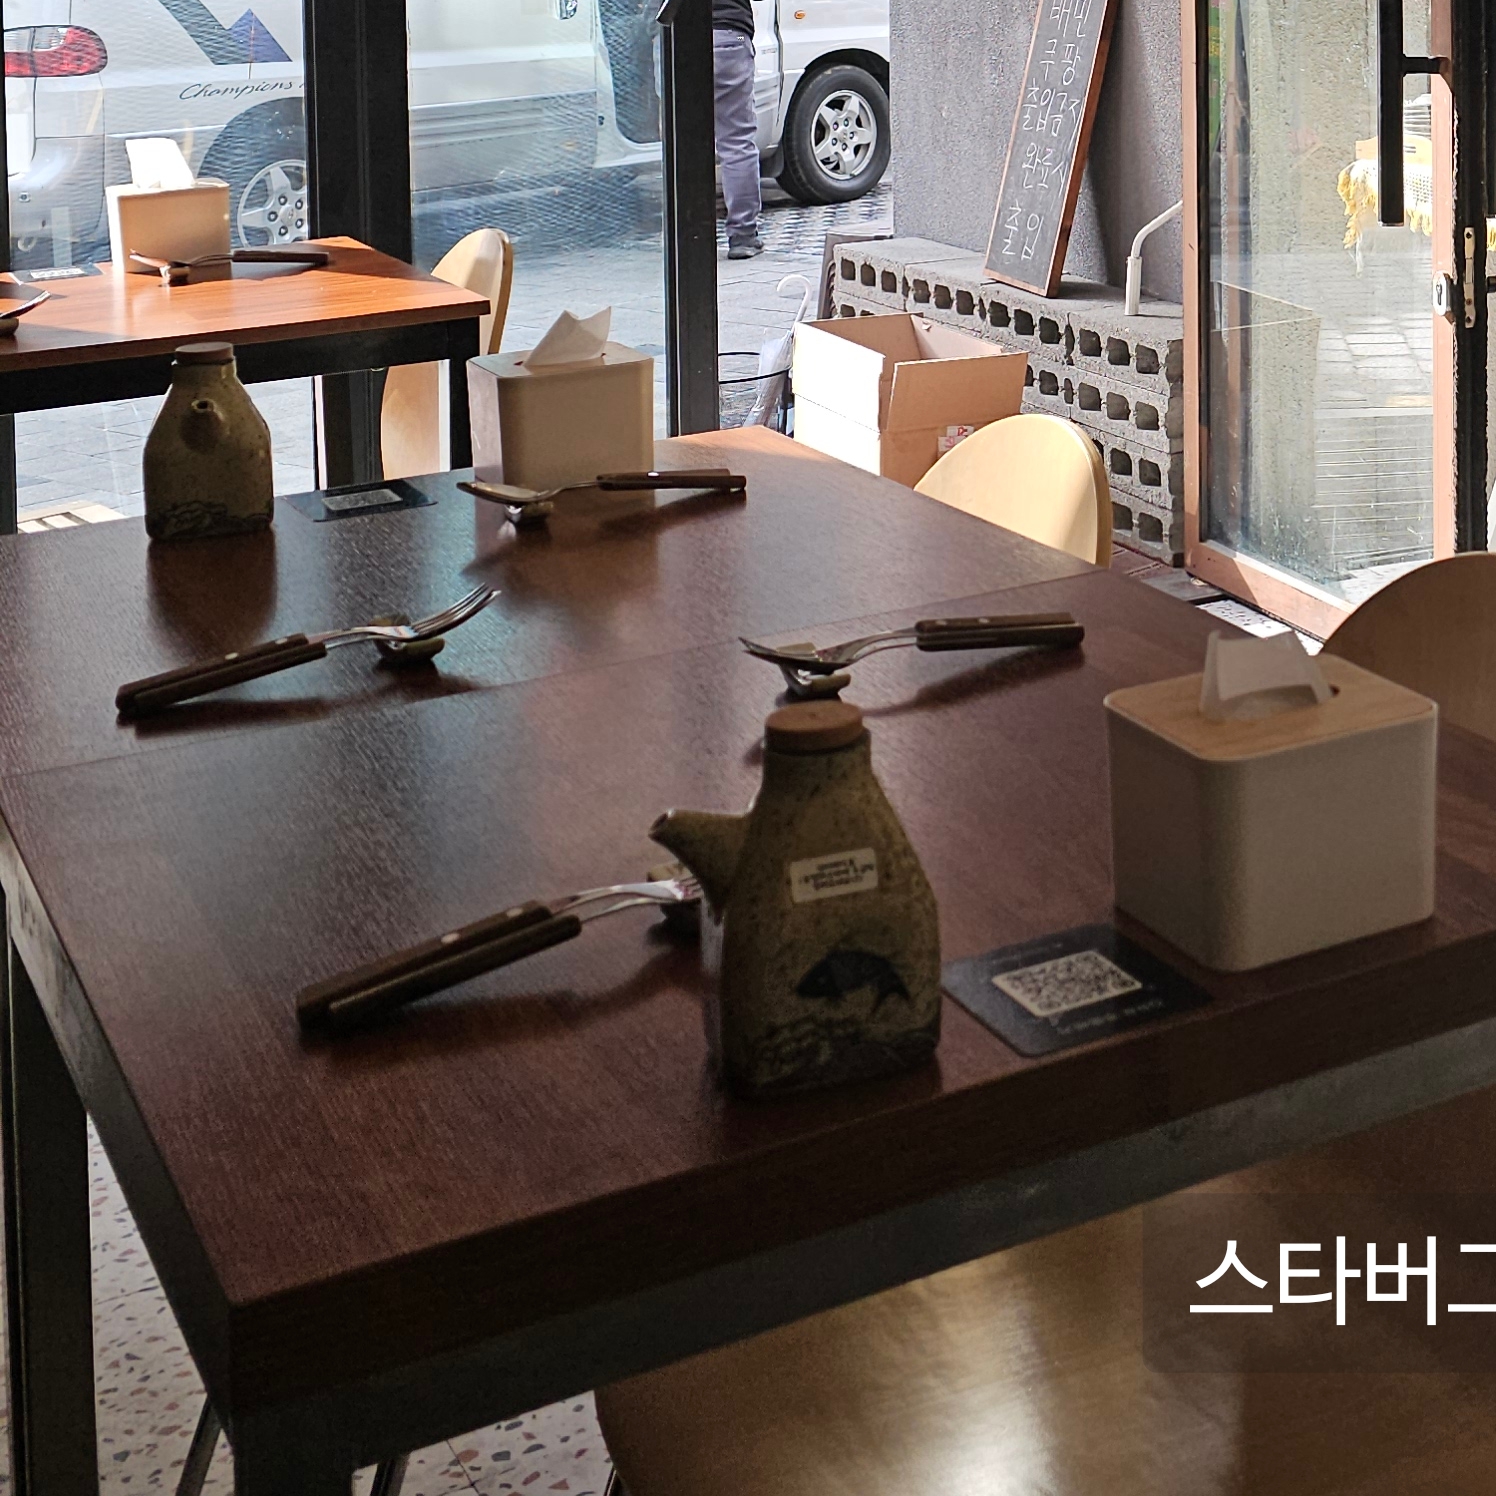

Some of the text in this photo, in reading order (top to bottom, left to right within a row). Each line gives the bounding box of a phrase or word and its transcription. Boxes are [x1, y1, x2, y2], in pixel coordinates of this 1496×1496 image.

[179, 81, 293, 100] Champions
[1022, 77, 1083, 152] 출입금지
[1001, 198, 1044, 261] 출입
